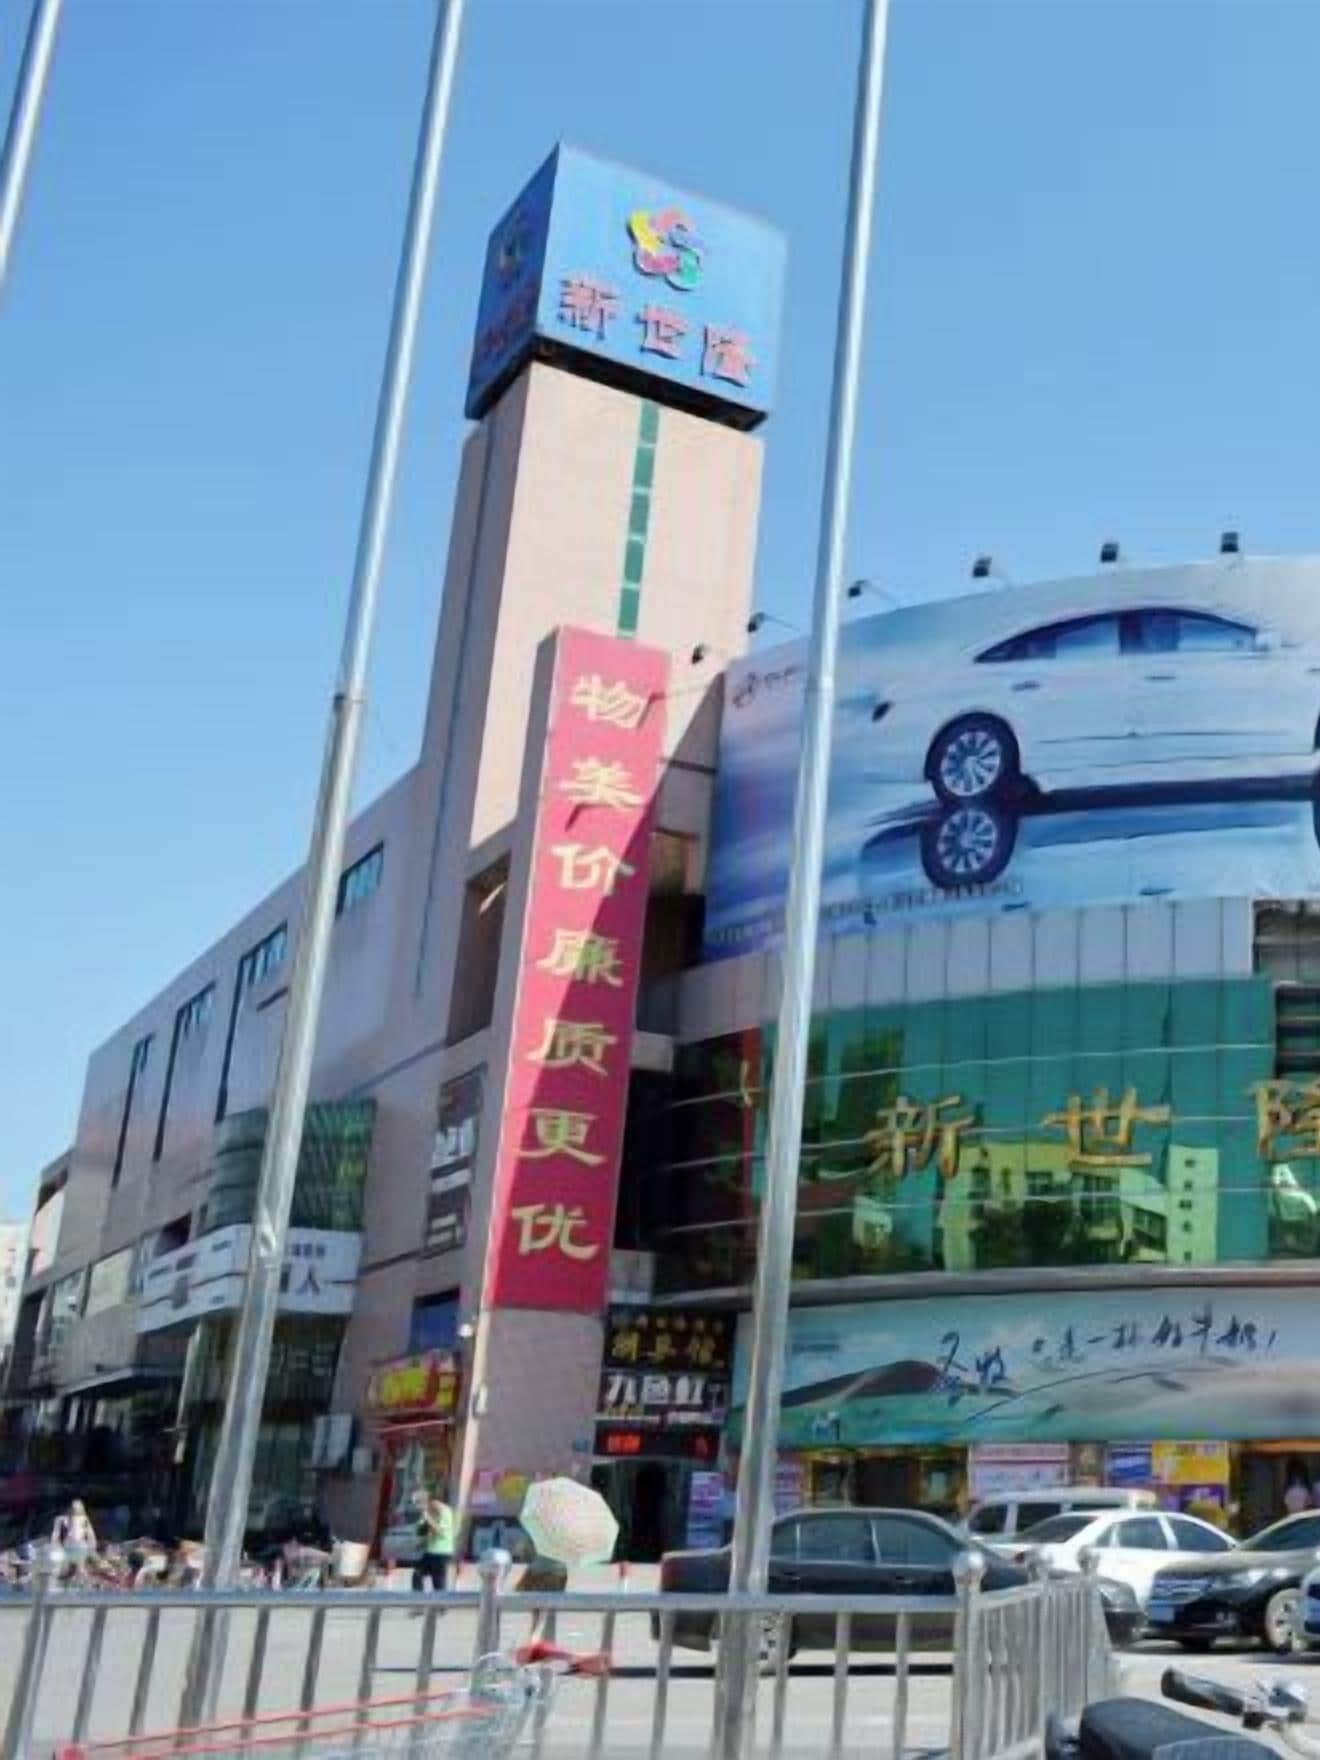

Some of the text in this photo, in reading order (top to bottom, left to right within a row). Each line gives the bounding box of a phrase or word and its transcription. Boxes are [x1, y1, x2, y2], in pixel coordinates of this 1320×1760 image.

[557, 272, 758, 388] 新世隆
[512, 675, 650, 1260] 物美价廉质更优
